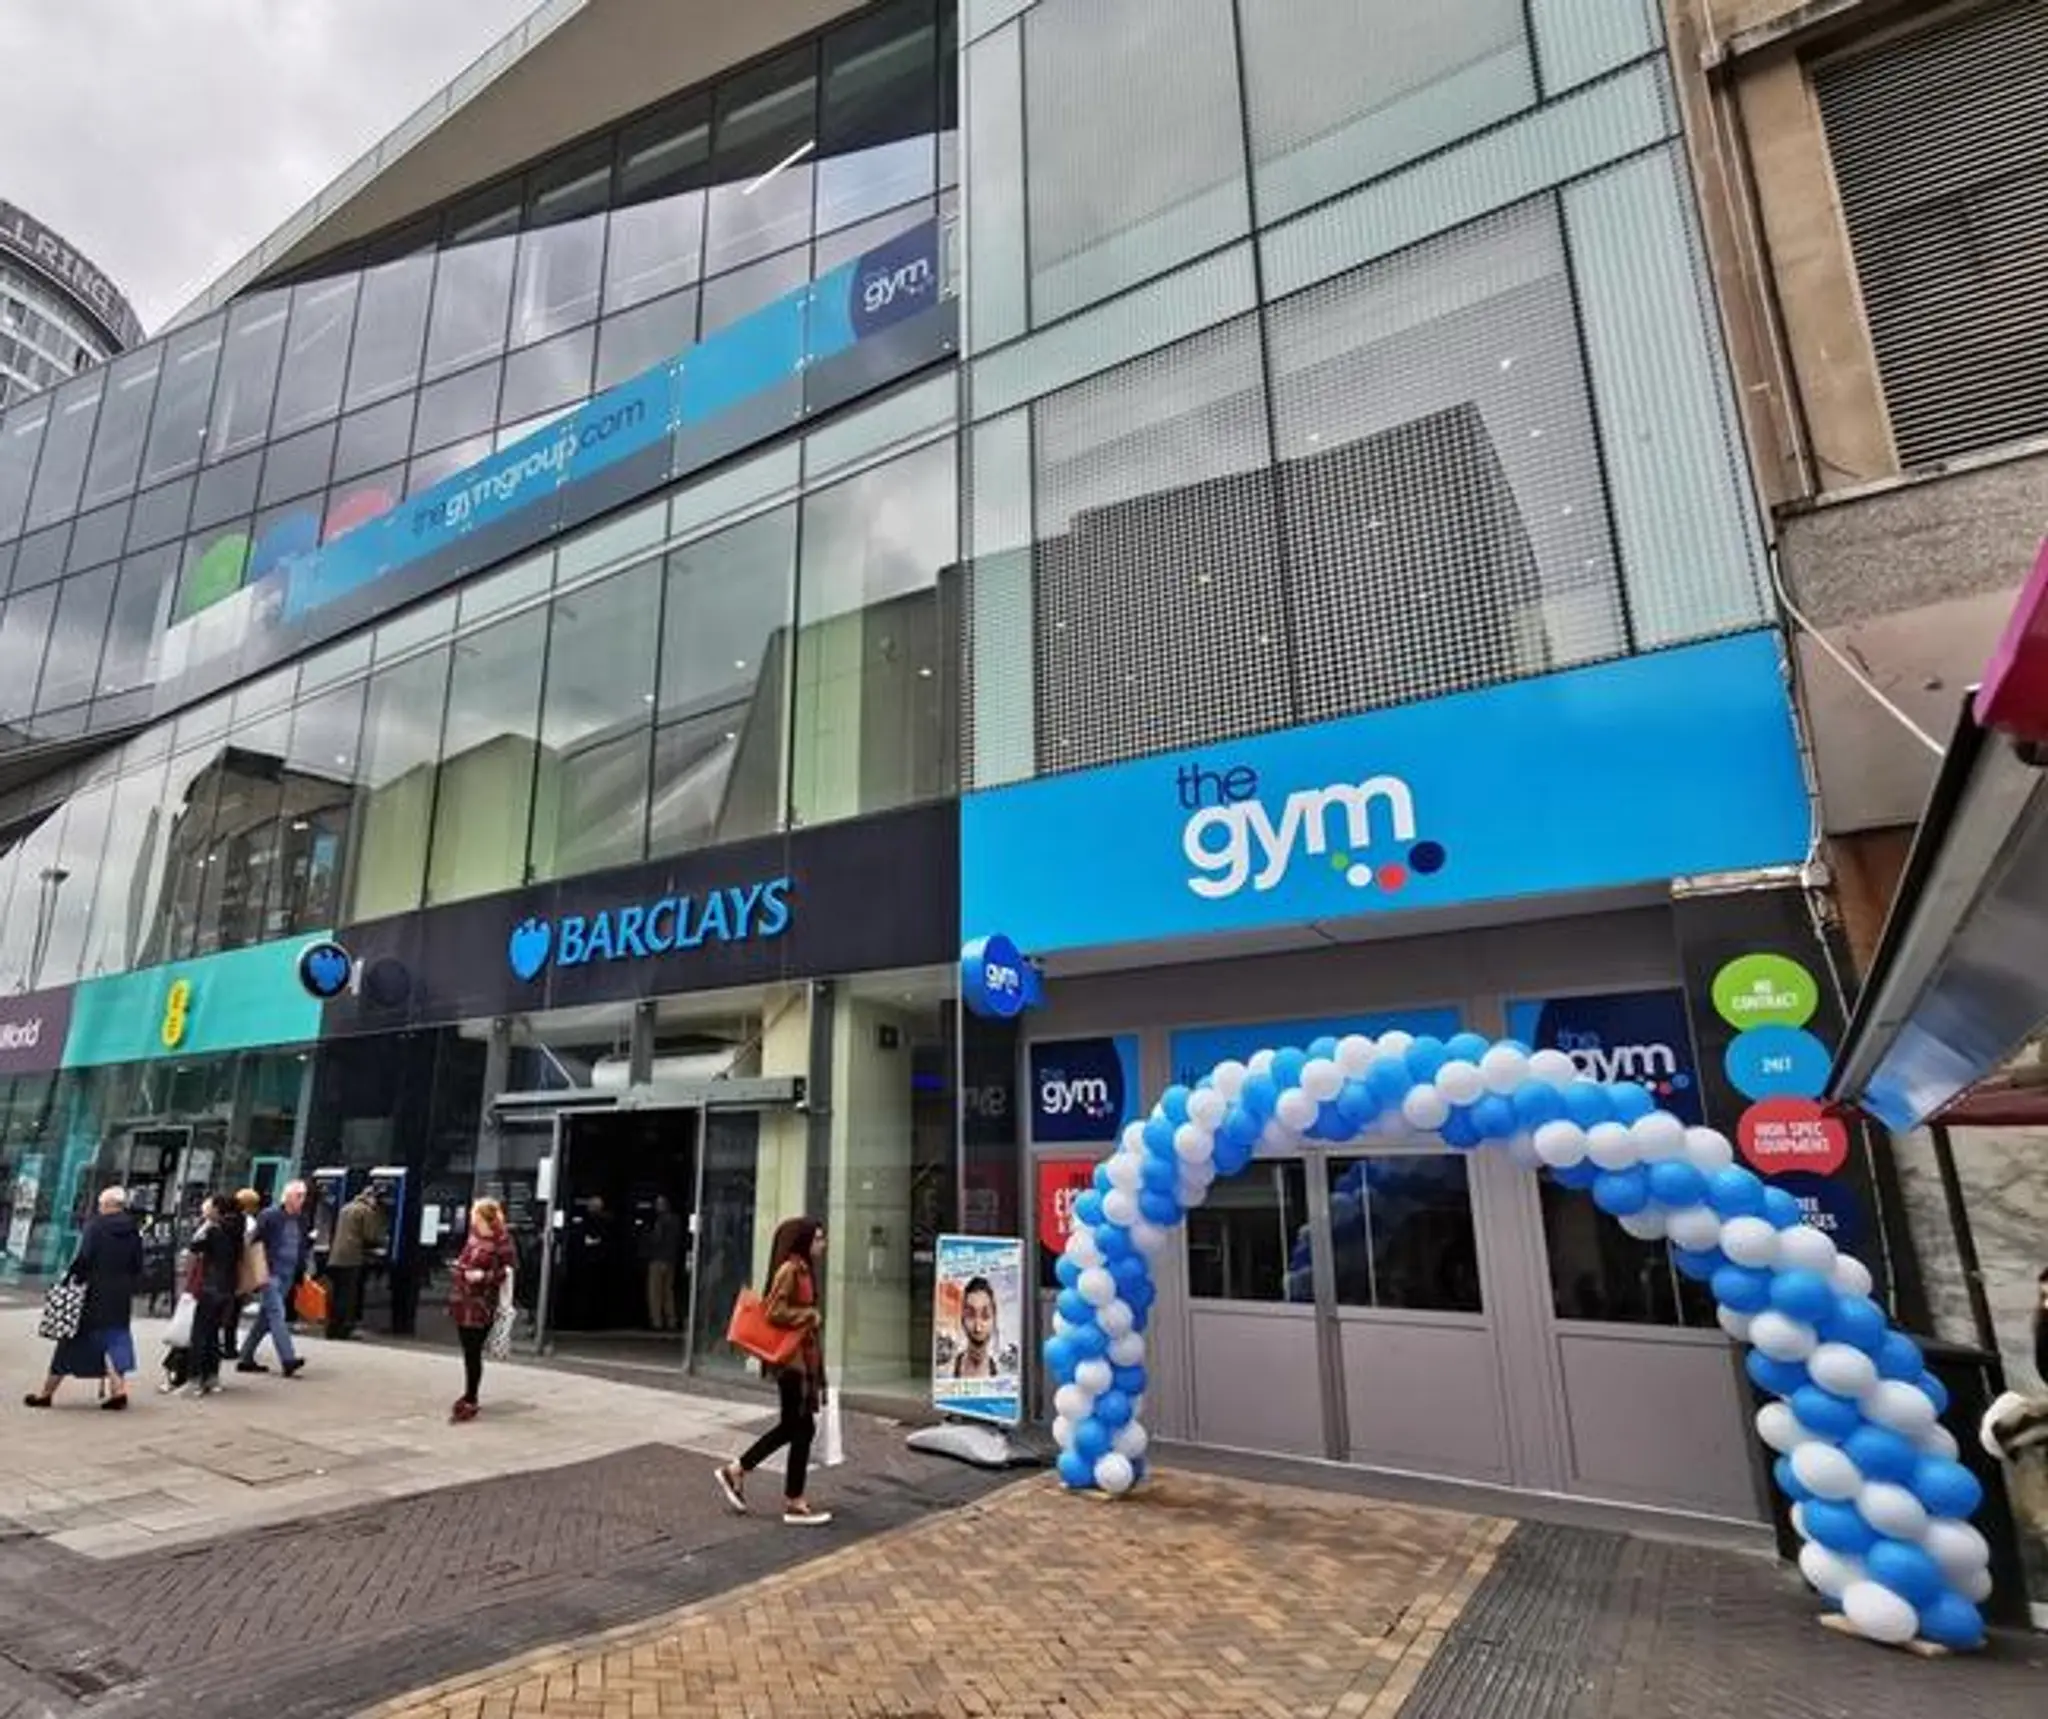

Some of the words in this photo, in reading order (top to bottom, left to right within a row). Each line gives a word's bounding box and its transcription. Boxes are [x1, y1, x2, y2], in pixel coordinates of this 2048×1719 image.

[863, 258, 928, 313] gym
[1176, 763, 1258, 810] the
[1182, 774, 1417, 898] gym
[555, 876, 790, 966] BARCLAYS
[985, 963, 1019, 991] gym
[1042, 1077, 1108, 1114] gym
